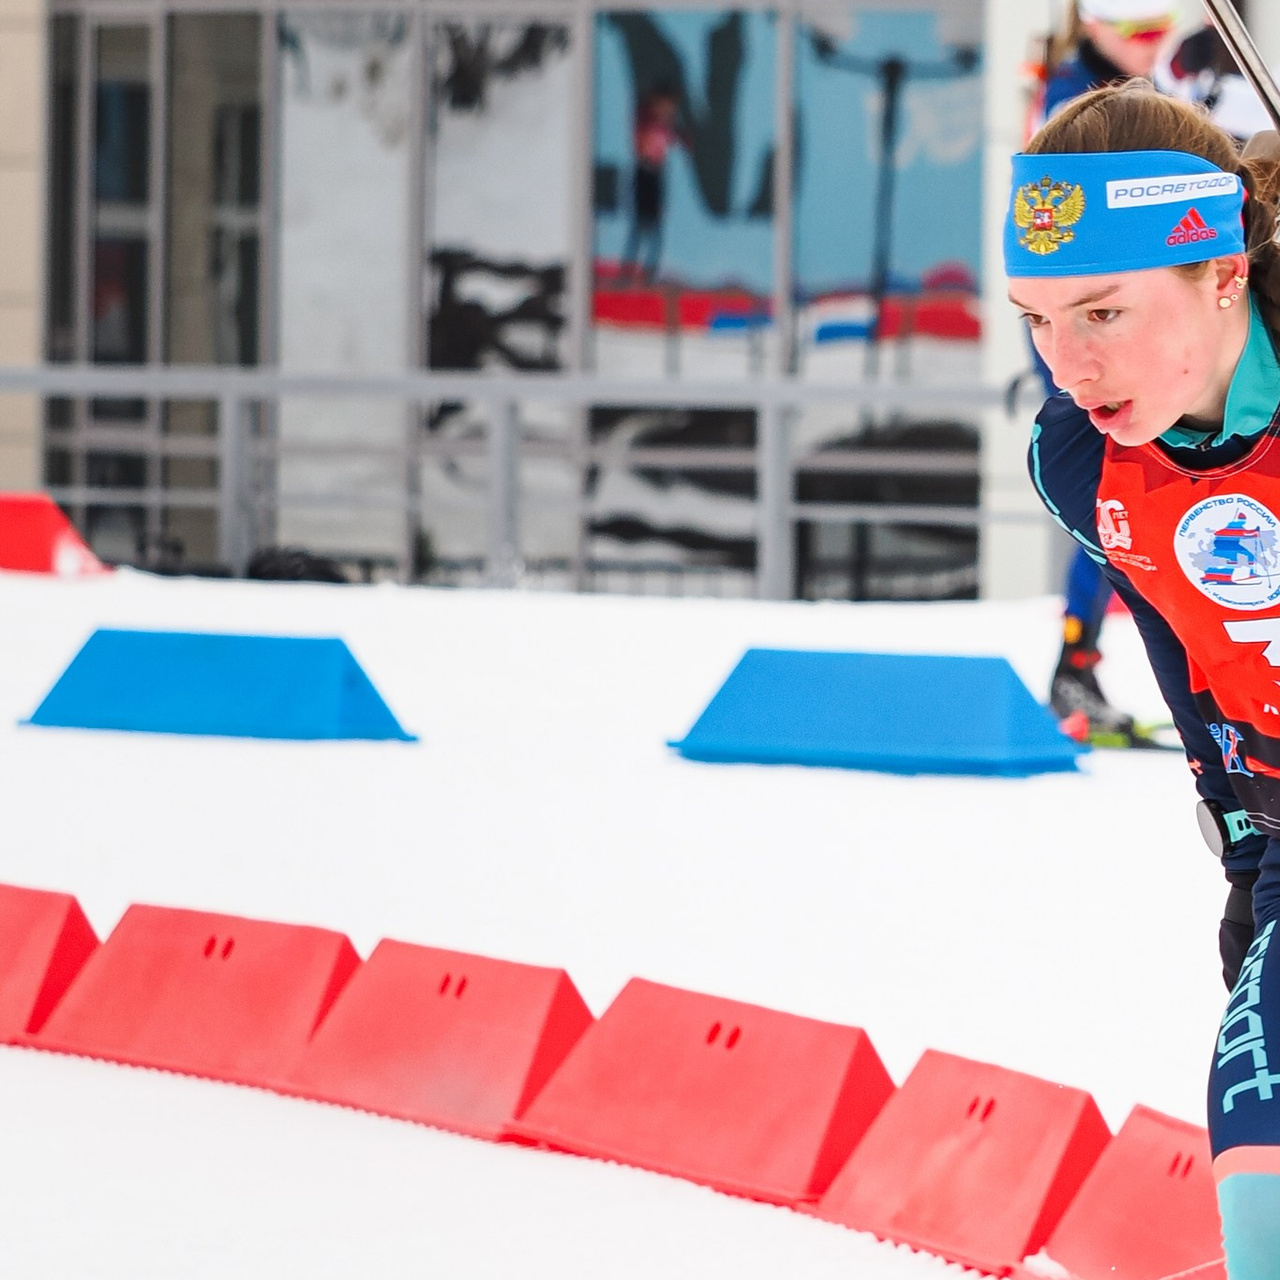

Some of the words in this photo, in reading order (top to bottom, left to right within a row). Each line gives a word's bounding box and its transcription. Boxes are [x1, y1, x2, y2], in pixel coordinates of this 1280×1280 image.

[1114, 176, 1234, 200] РОСАВТОДОР
[1166, 228, 1217, 246] adidas
[1179, 497, 1234, 537] ПЕРВЕНСТВО
[1236, 497, 1277, 528] РОССИИ
